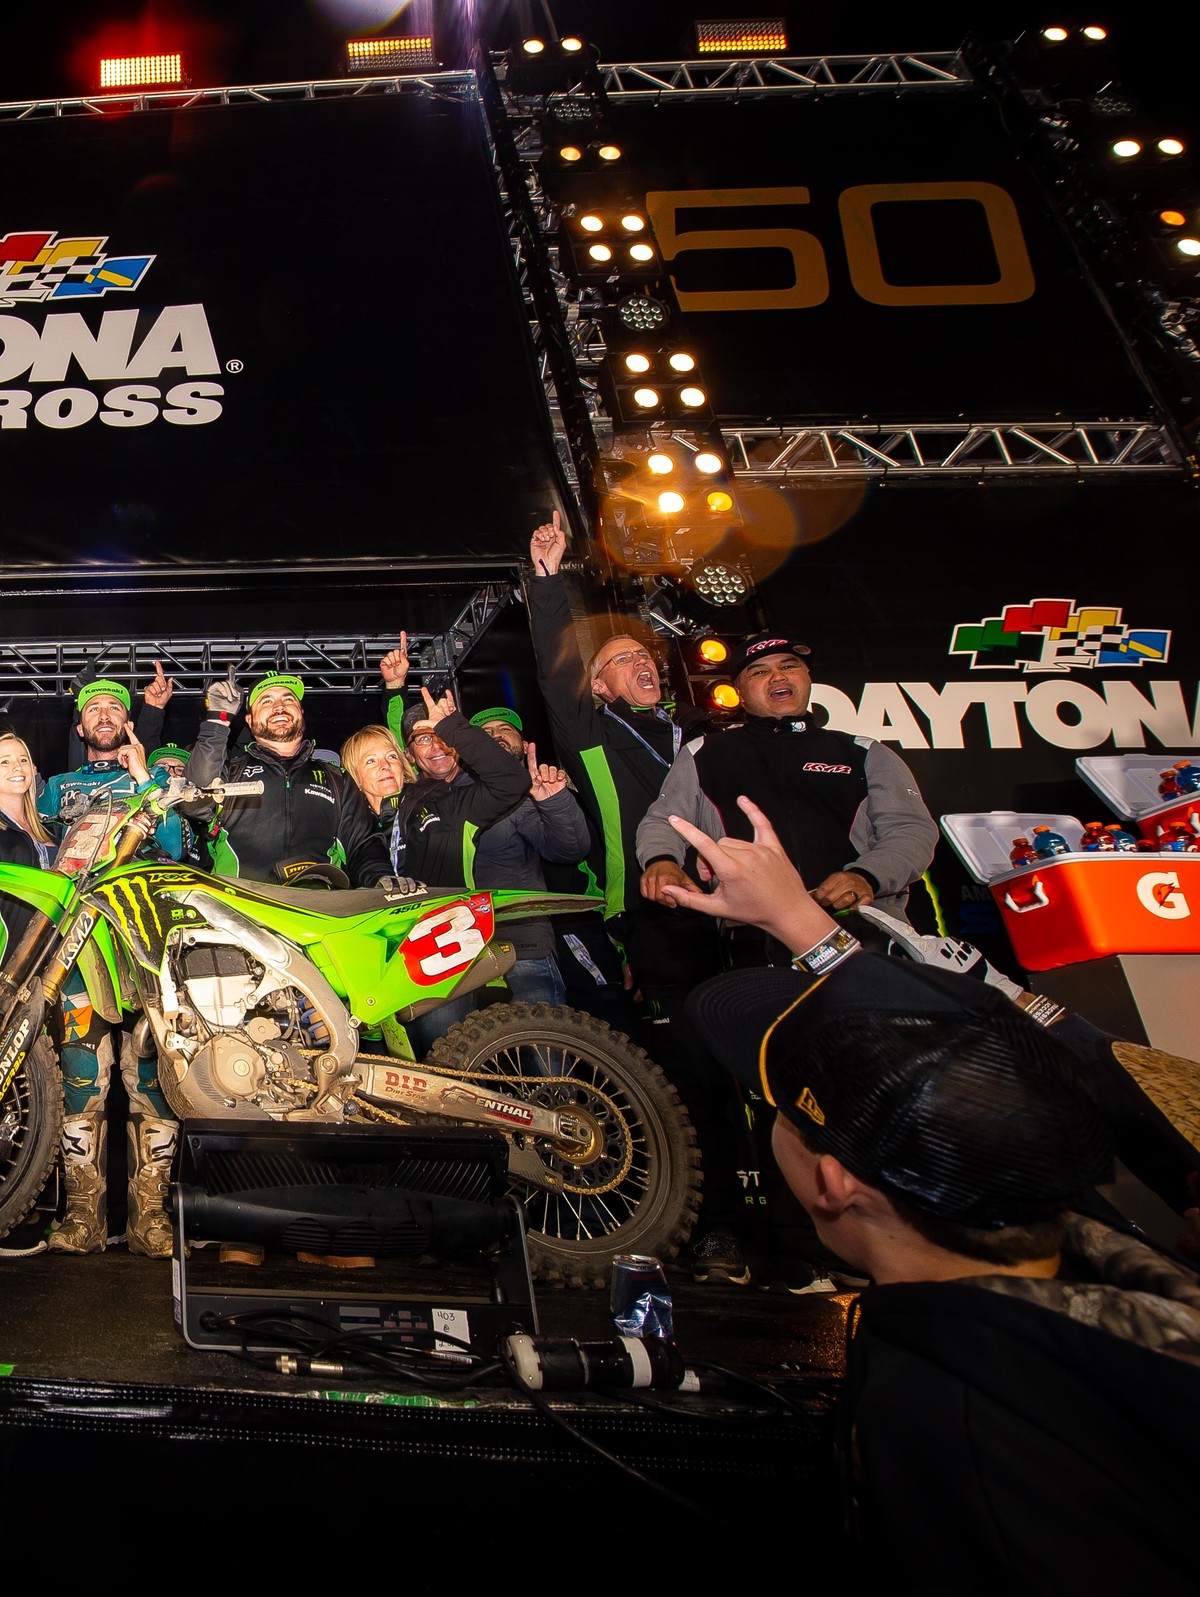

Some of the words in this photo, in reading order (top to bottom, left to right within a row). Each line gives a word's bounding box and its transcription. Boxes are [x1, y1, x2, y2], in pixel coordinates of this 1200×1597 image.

[646, 181, 1036, 312] 50
[84, 687, 124, 695] Kawasaki
[257, 679, 298, 691] Kawasaki
[806, 680, 1200, 748] DAYTON
[60, 780, 101, 791] Kawasaki
[304, 788, 335, 804] Kawasaki
[1136, 871, 1191, 920] G
[389, 902, 423, 915] 450
[407, 904, 485, 977] 3
[437, 1310, 456, 1322] 403
